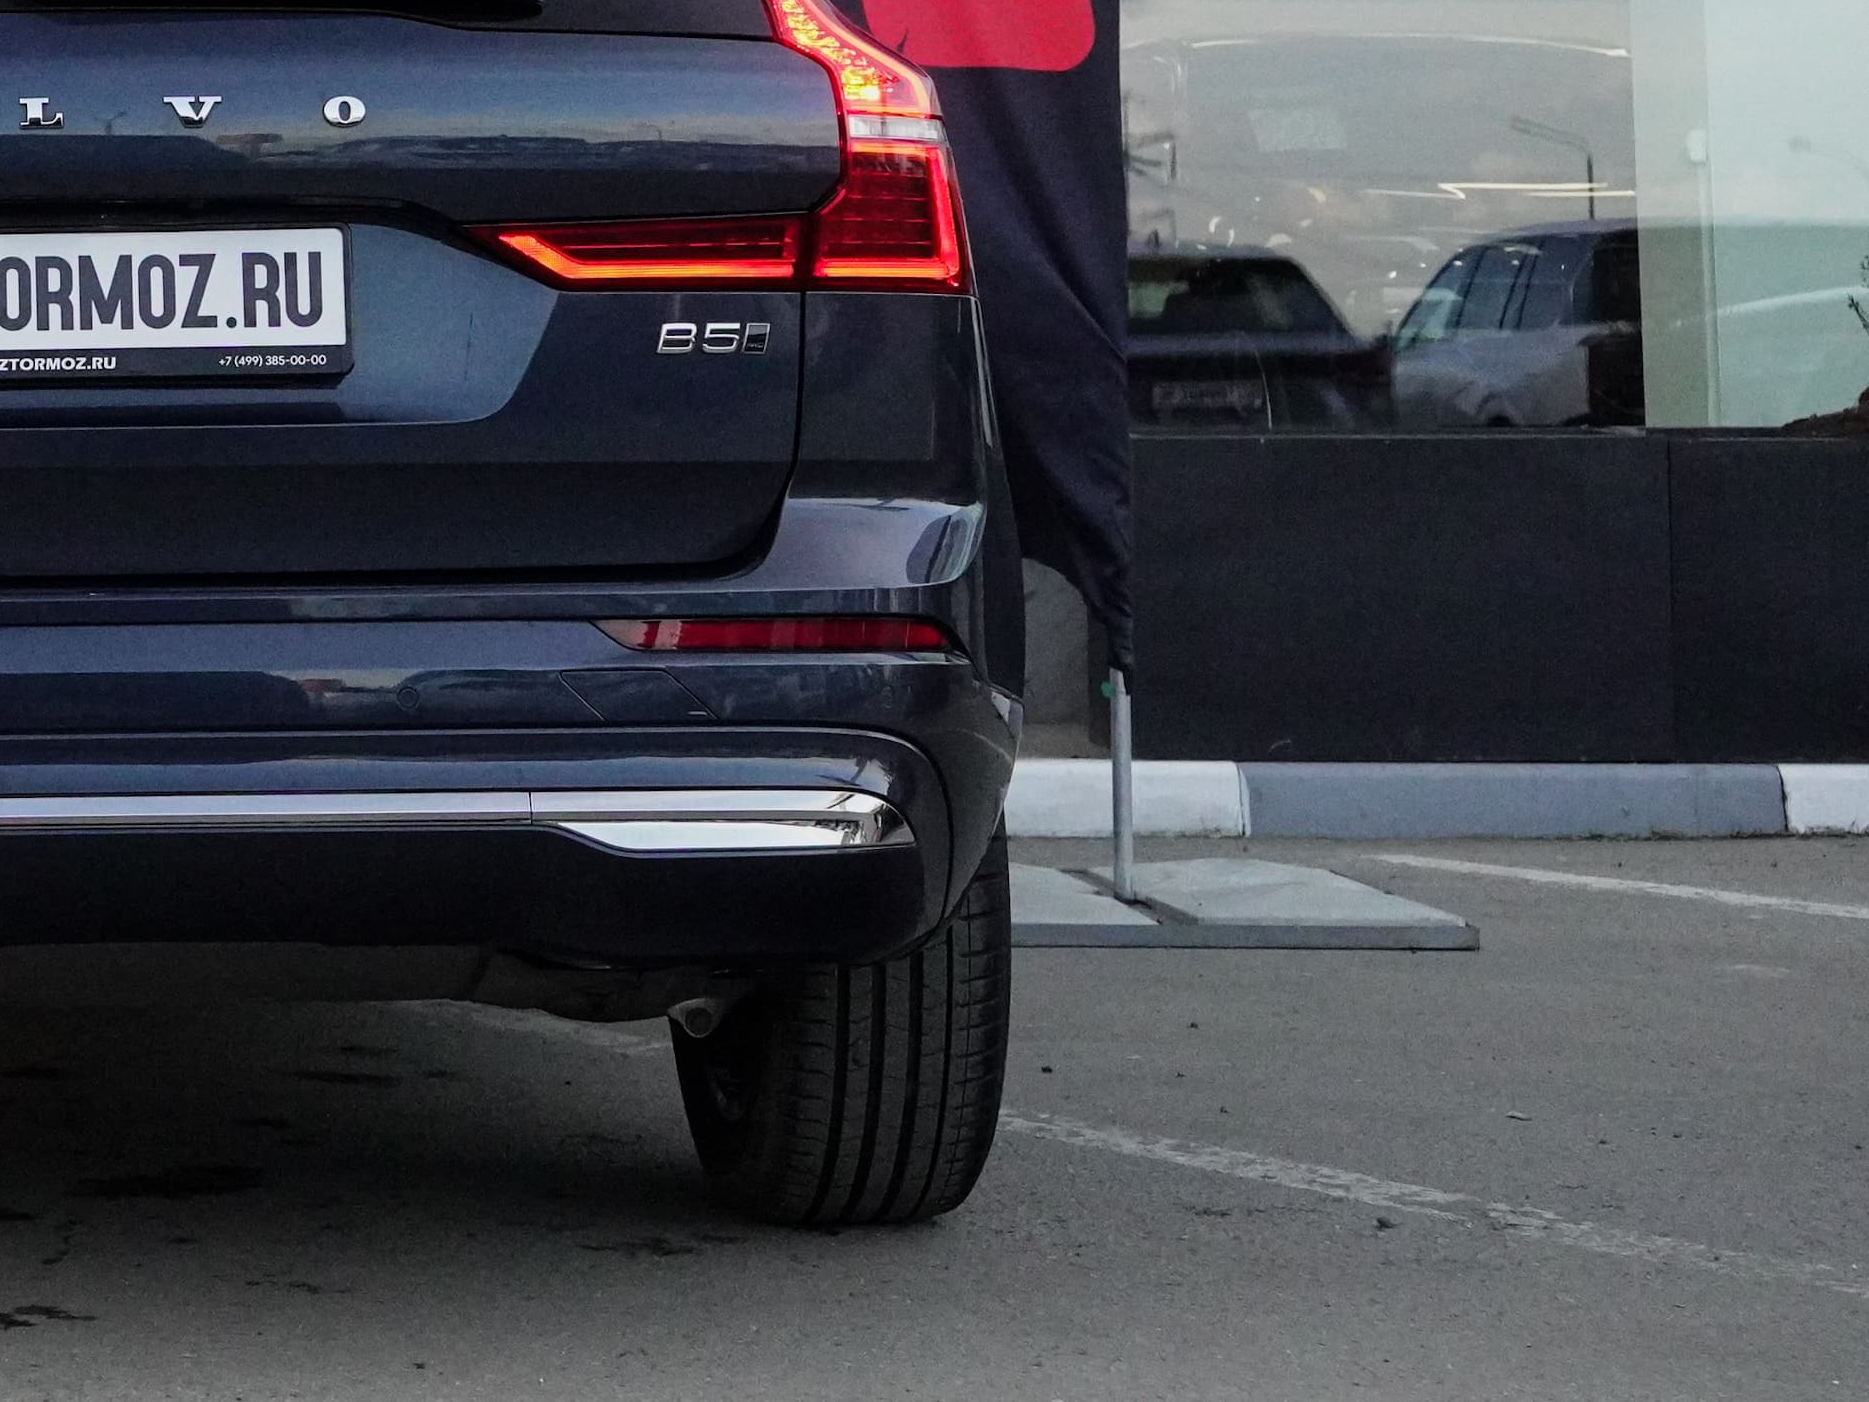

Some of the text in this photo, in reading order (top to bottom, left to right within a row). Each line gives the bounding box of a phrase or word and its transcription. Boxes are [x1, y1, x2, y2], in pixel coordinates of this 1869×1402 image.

[656, 322, 740, 354] B5
[218, 354, 327, 367] +7 (499) 385-00-00
